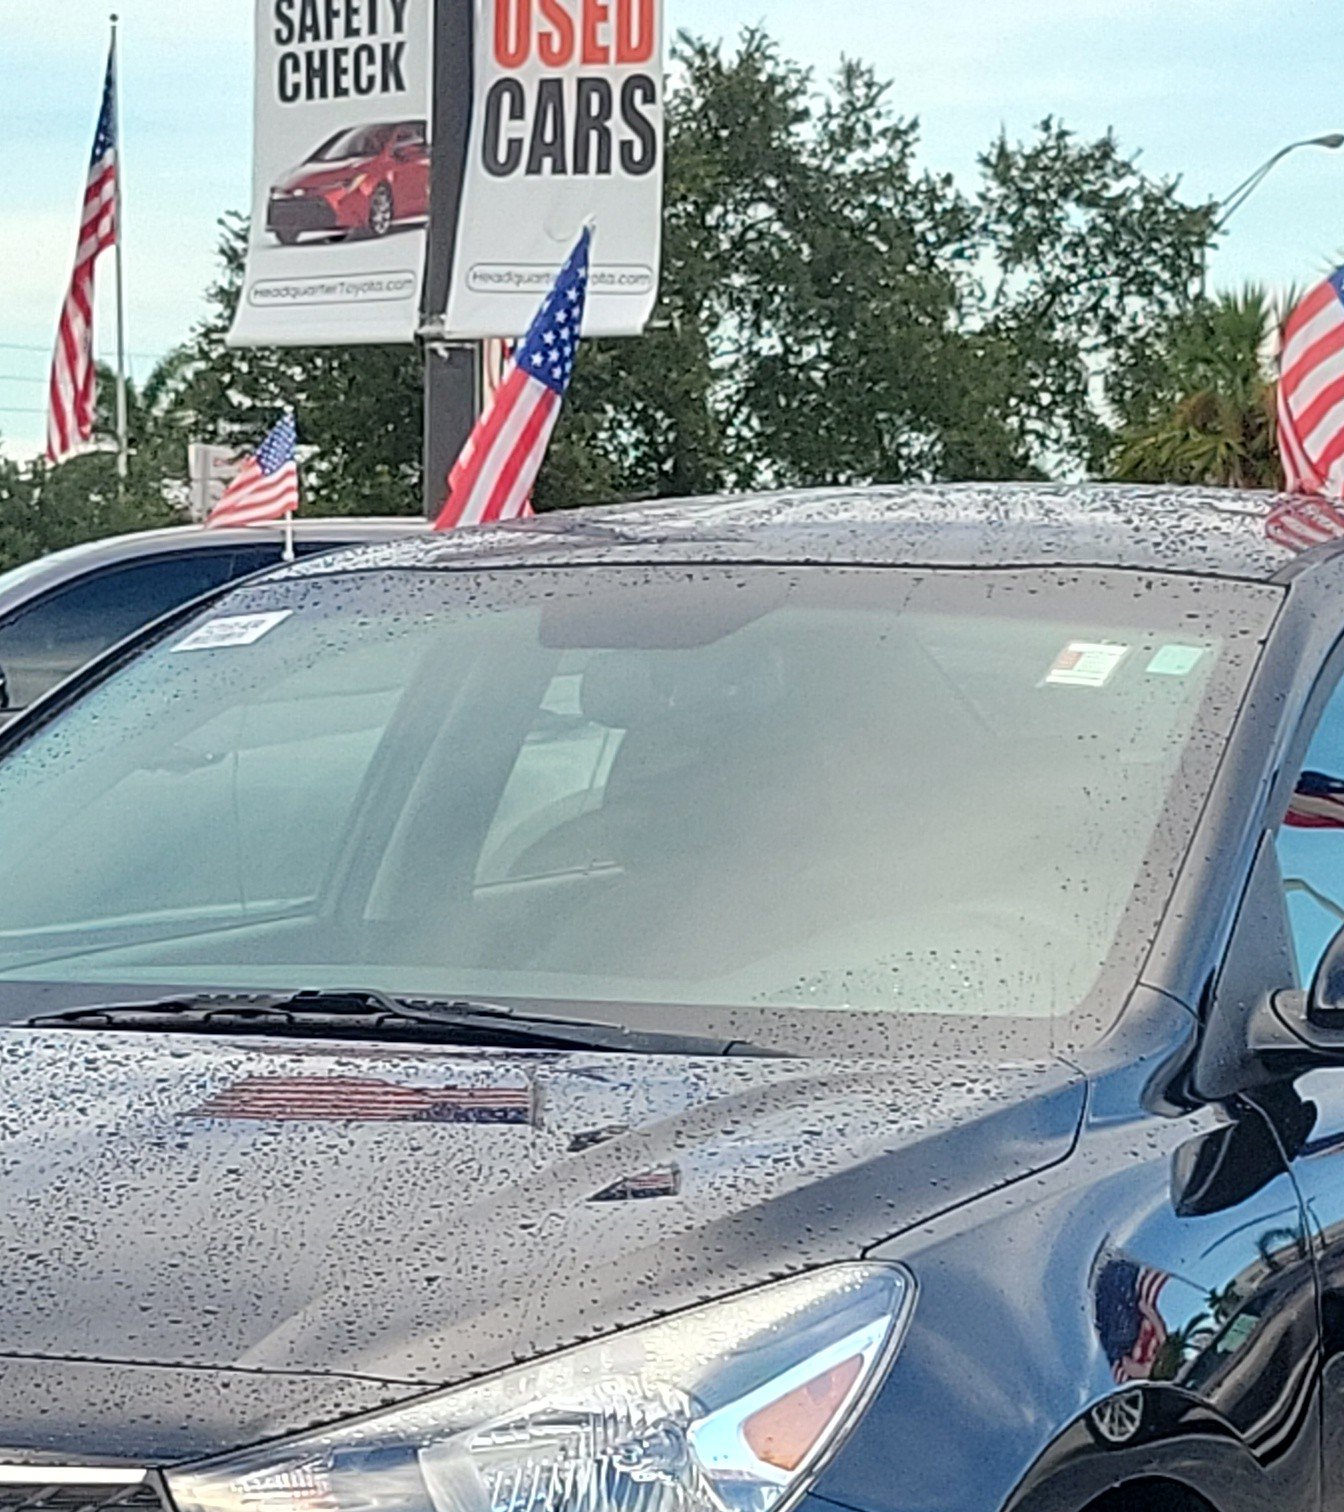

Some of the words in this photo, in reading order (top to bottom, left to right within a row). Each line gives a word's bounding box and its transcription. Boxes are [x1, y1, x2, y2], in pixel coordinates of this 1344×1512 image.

[274, 0, 407, 46] SAFETY
[493, 0, 654, 69] USED
[277, 41, 406, 103] CHECK
[481, 74, 657, 178] CARS
